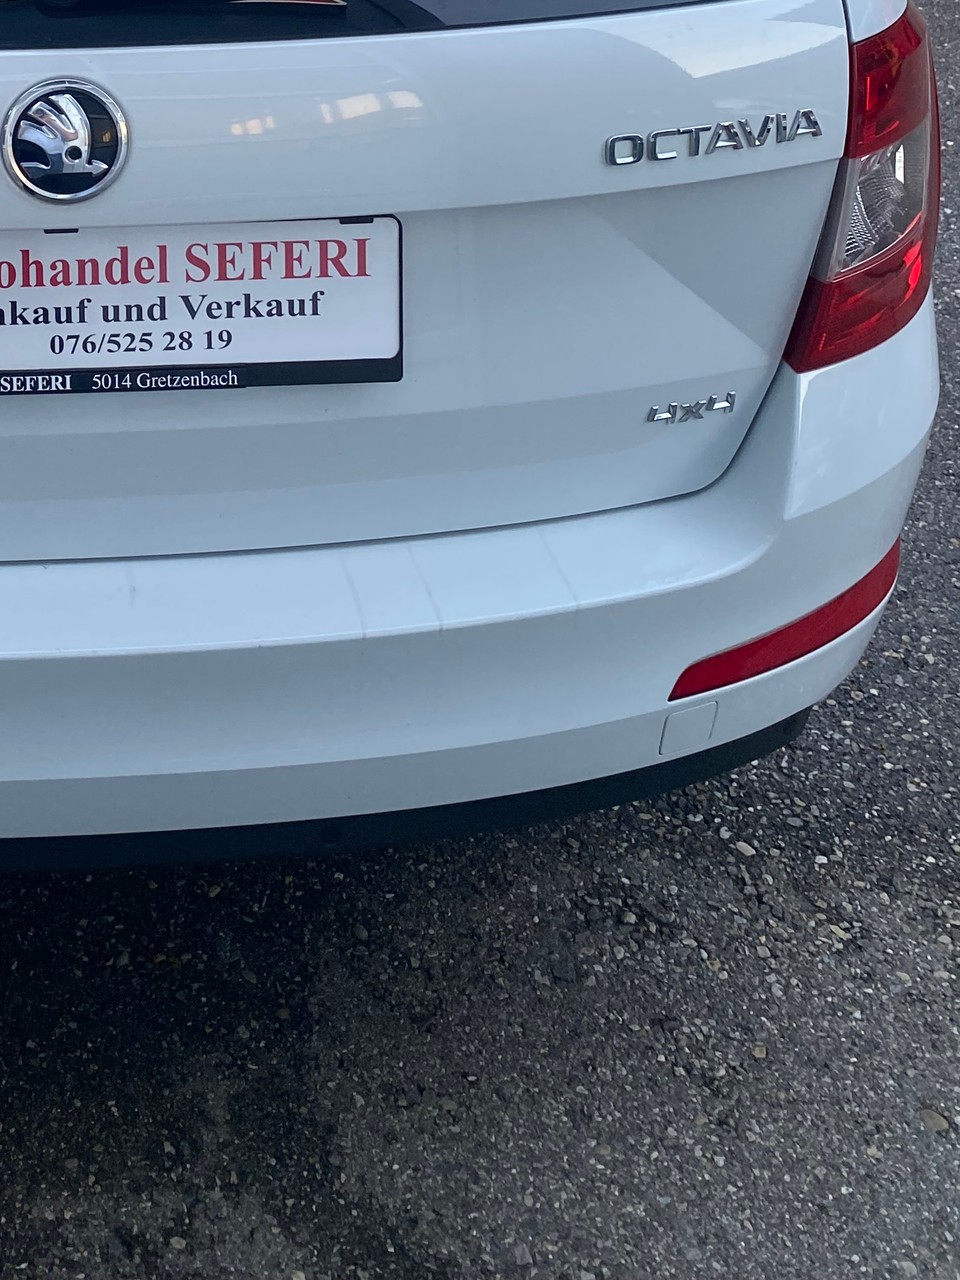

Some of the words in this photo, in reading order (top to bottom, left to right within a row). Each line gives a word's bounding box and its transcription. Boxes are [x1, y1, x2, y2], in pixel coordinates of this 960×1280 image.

[605, 108, 823, 166] OCTAVIA
[184, 238, 371, 283] SEFERI
[100, 296, 168, 322] und
[179, 290, 325, 320] Verkauf
[49, 332, 153, 355] 076/525
[162, 331, 193, 351] 28
[204, 329, 233, 350] 19
[0, 375, 72, 392] SEFERI
[91, 372, 132, 390] 5014
[136, 369, 238, 389] Gretzenbach
